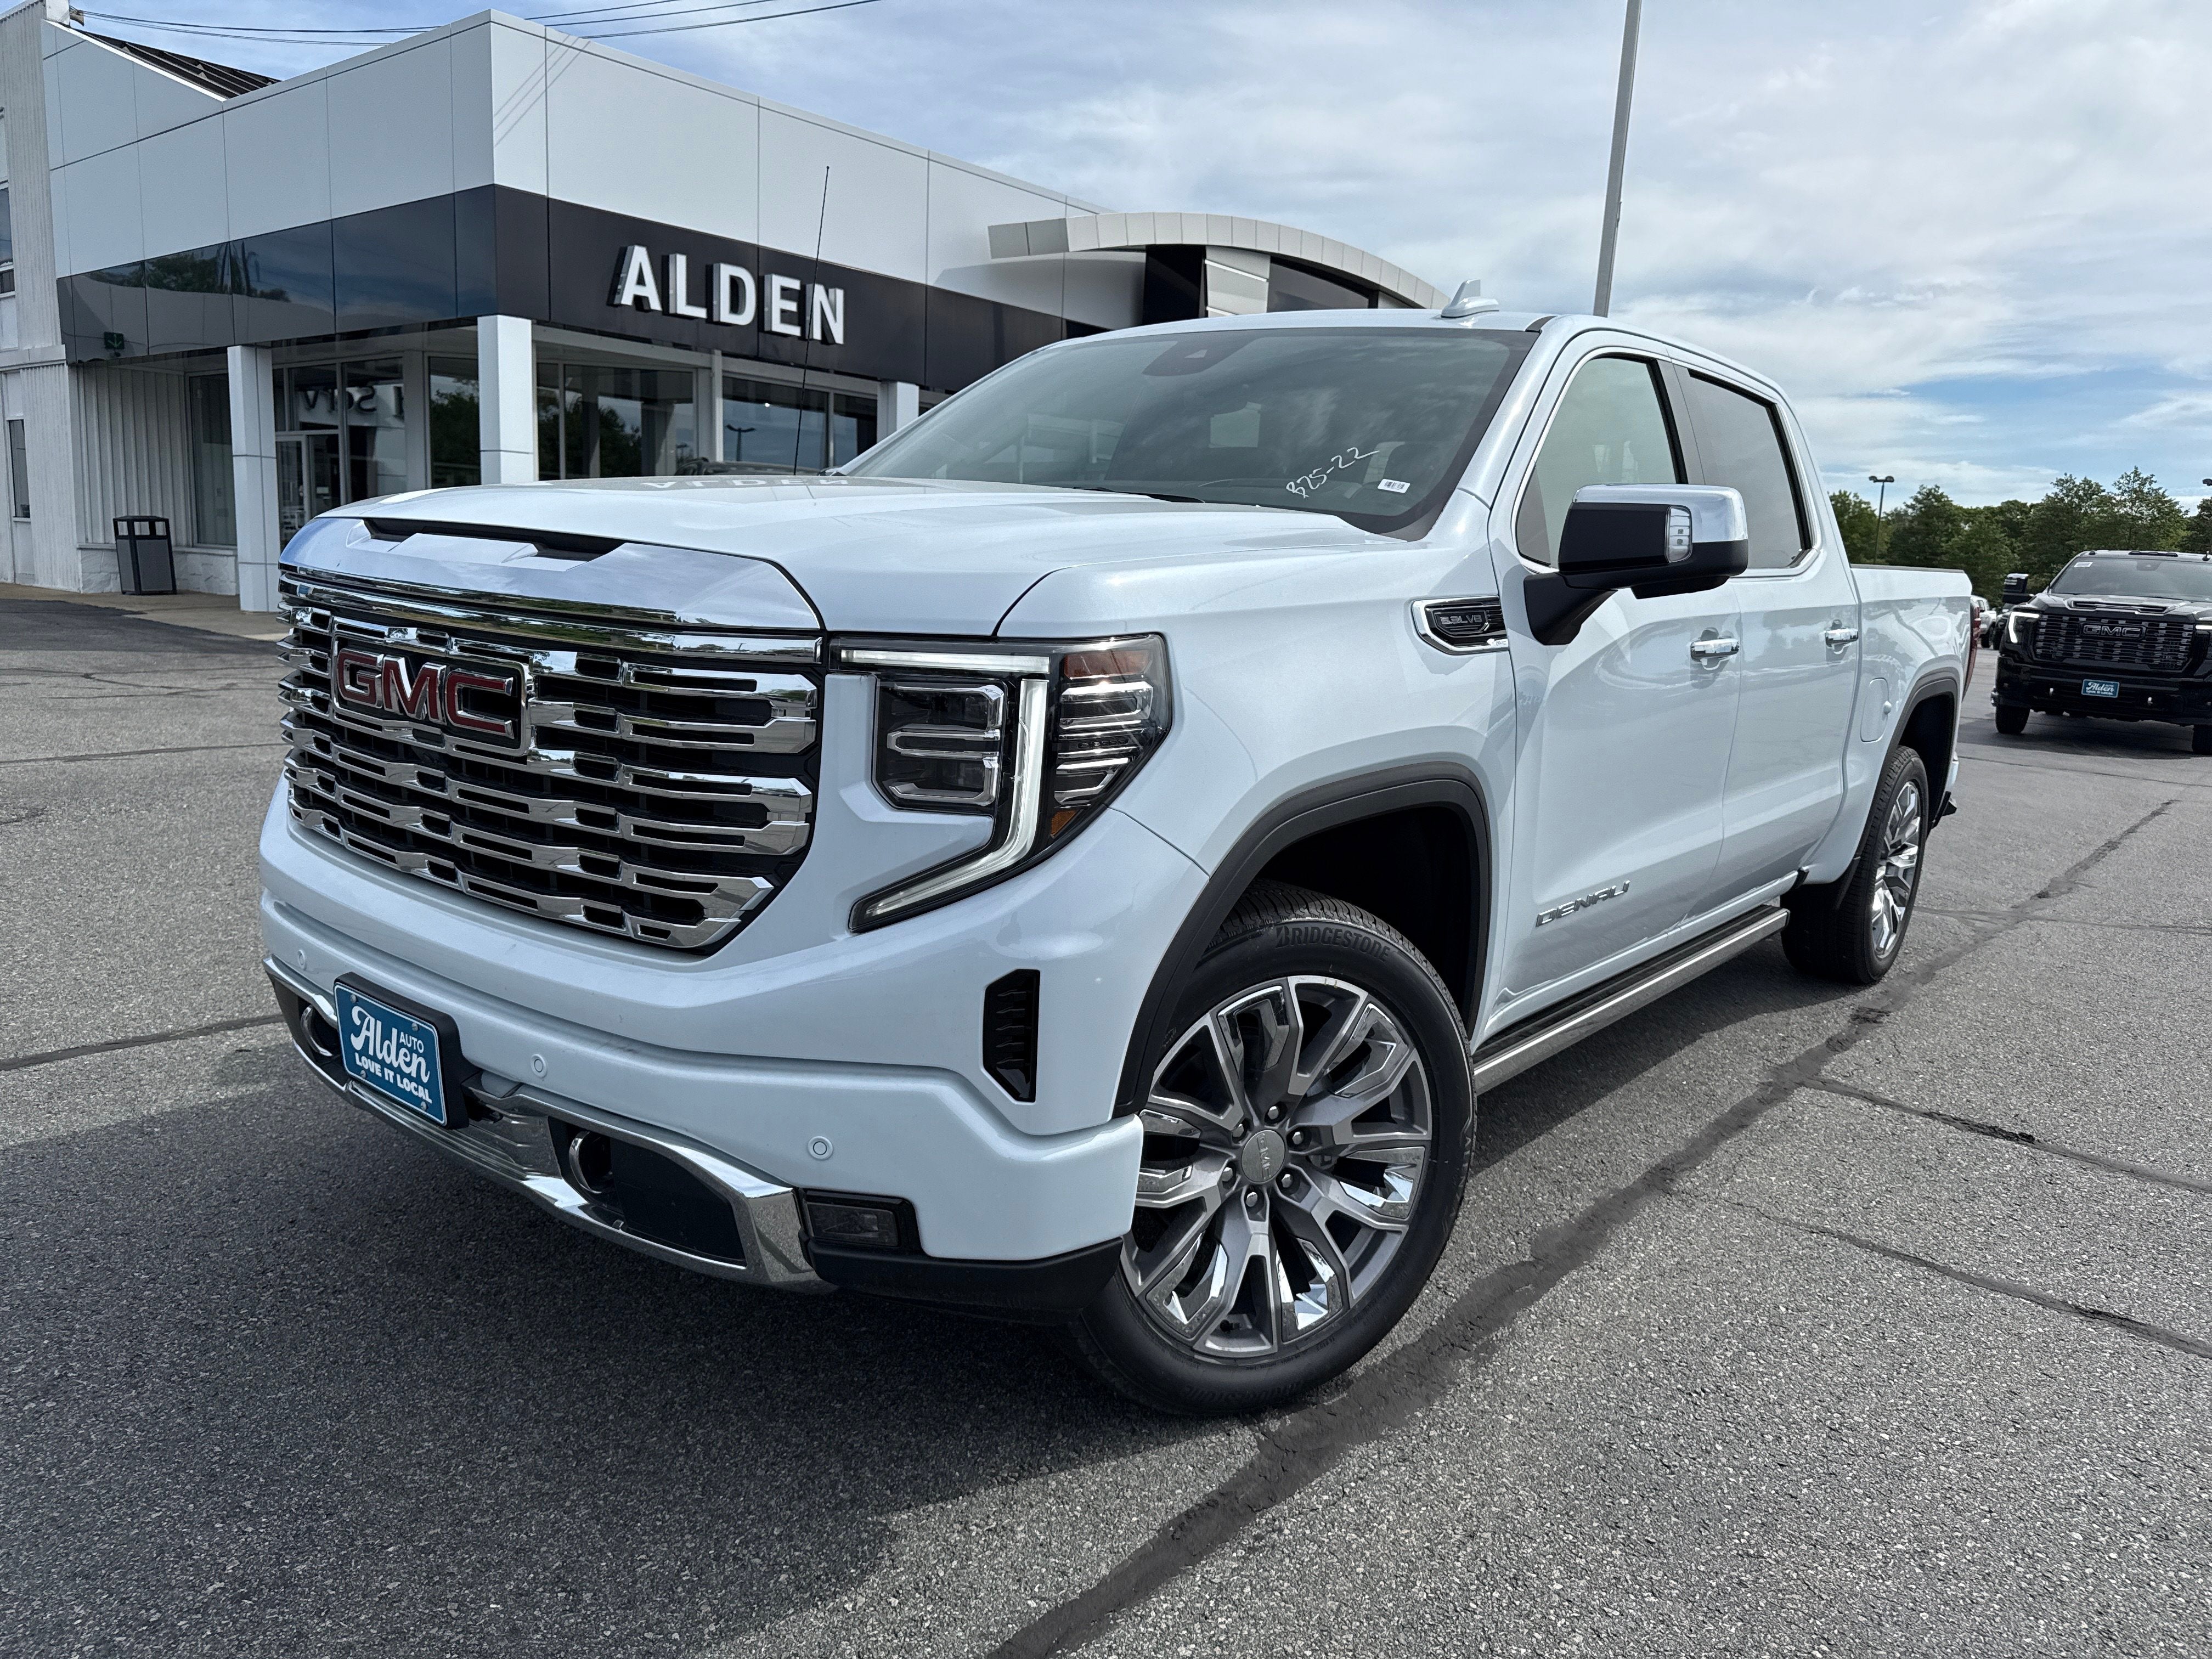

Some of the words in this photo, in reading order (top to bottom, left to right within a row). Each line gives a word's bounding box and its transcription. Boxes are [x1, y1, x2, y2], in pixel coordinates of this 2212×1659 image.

[614, 245, 844, 345] ALDEN
[2083, 624, 2140, 637] GMC
[337, 647, 514, 740] GMC
[2086, 682, 2114, 692] Alden
[1535, 880, 1630, 928] DENALI
[1275, 925, 1392, 962] BRIDGESTONE
[351, 1006, 430, 1084] Alden
[399, 1031, 424, 1053] AUTO
[355, 1052, 382, 1077] LOVE
[384, 1067, 394, 1084] IT
[396, 1073, 432, 1104] LOCAL
